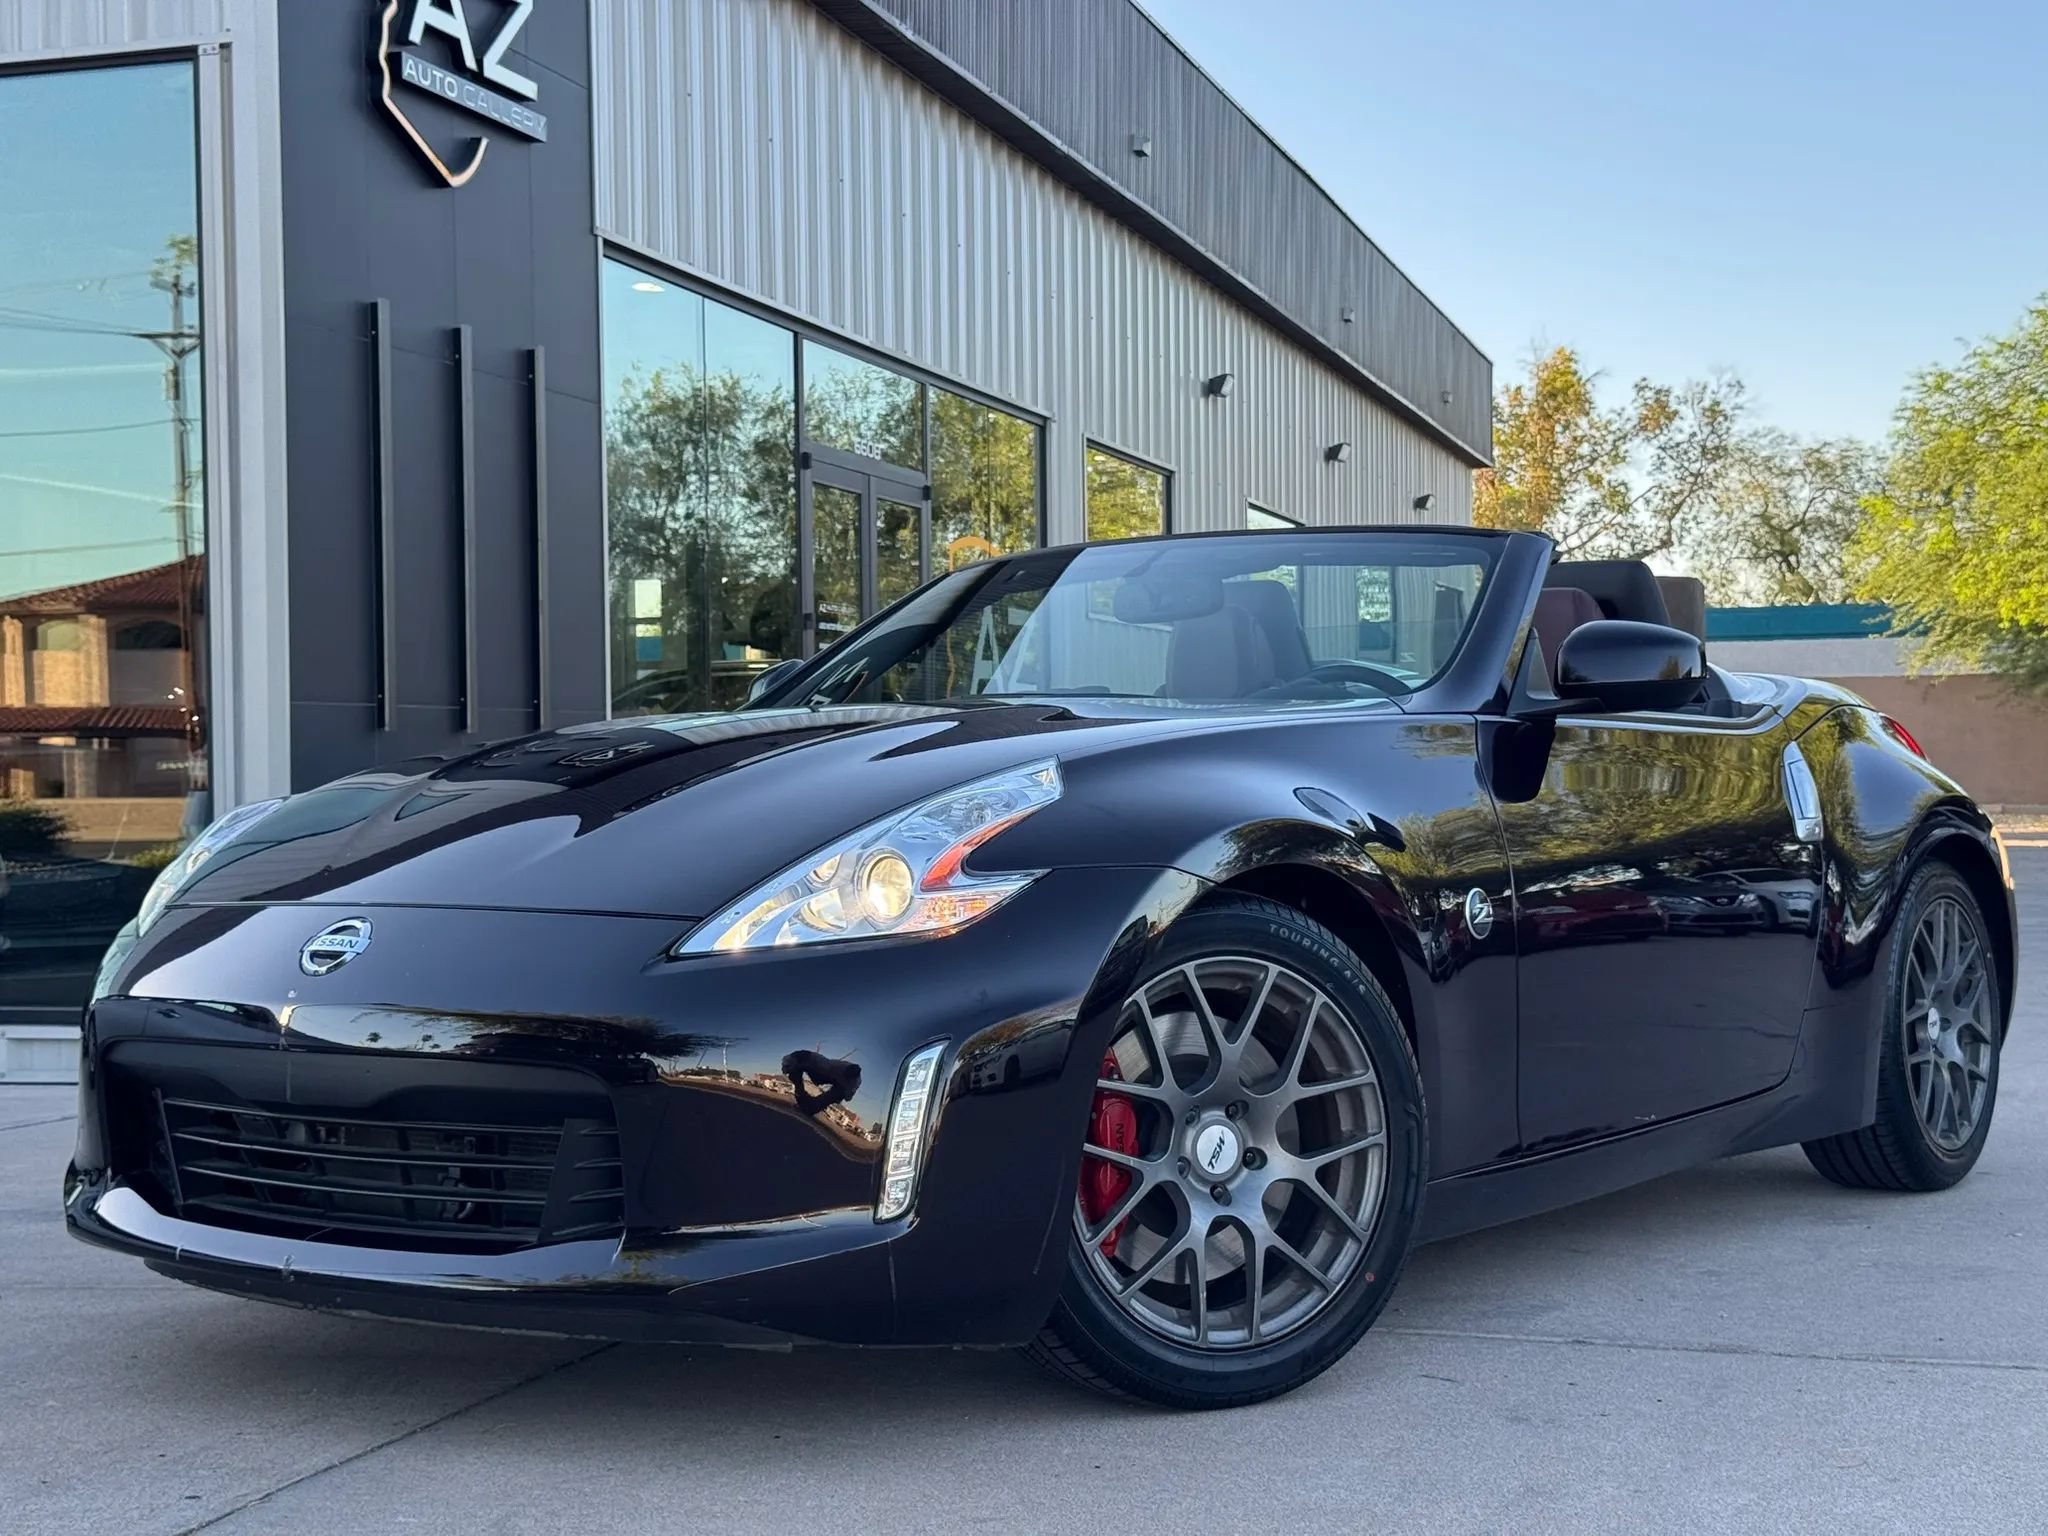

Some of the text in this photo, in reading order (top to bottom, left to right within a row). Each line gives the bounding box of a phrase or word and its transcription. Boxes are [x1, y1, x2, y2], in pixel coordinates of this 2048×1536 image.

[408, 0, 539, 103] AZ
[404, 59, 459, 98] AUTO
[314, 937, 360, 949] ISSAN
[1268, 922, 1340, 968] TOURING
[1207, 1129, 1226, 1170] TSW
